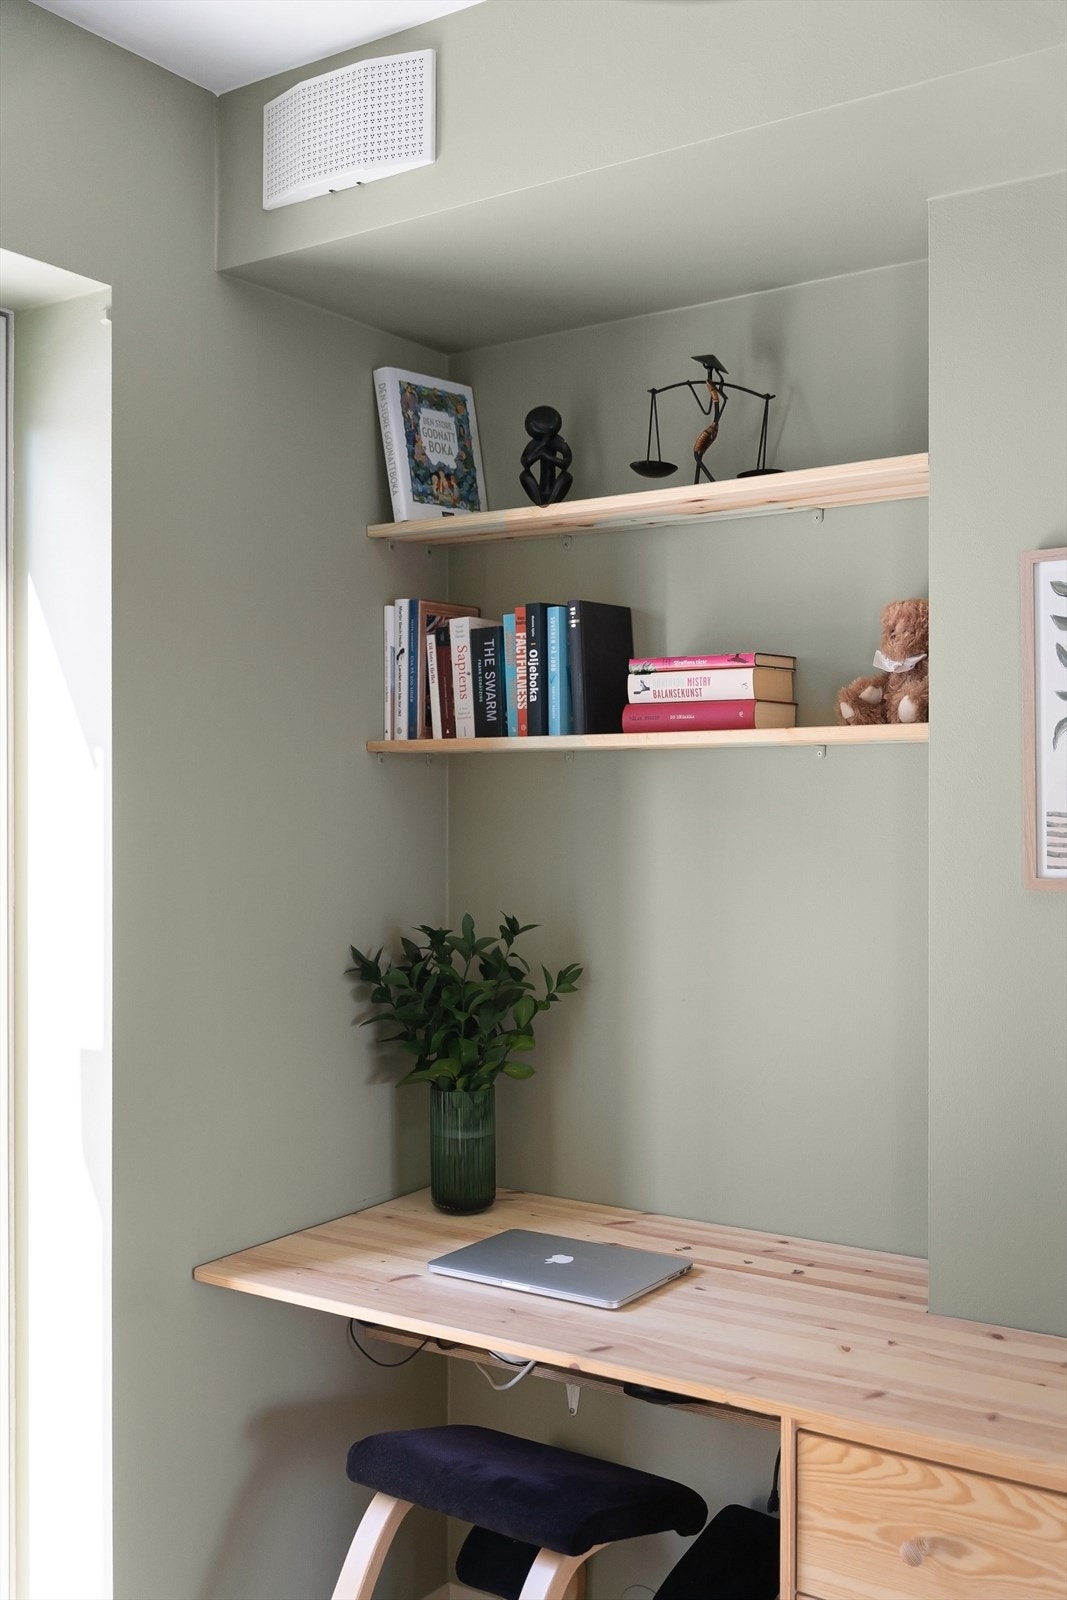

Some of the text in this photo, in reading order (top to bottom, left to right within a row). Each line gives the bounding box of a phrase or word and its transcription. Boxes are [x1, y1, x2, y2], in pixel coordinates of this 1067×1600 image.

[378, 383, 399, 497] DEN STORE GODNATTBOKA
[421, 427, 456, 443] GODNATT
[422, 416, 453, 430] DEN STORE
[428, 442, 454, 457] BOKA
[455, 645, 469, 700] Sapiens
[484, 638, 498, 722] THE SWARM
[515, 632, 527, 710] FACTFULNESS
[528, 648, 539, 703] Oljeboka
[687, 676, 711, 687] MISTRY
[652, 688, 702, 699] BALANSEKUNST
